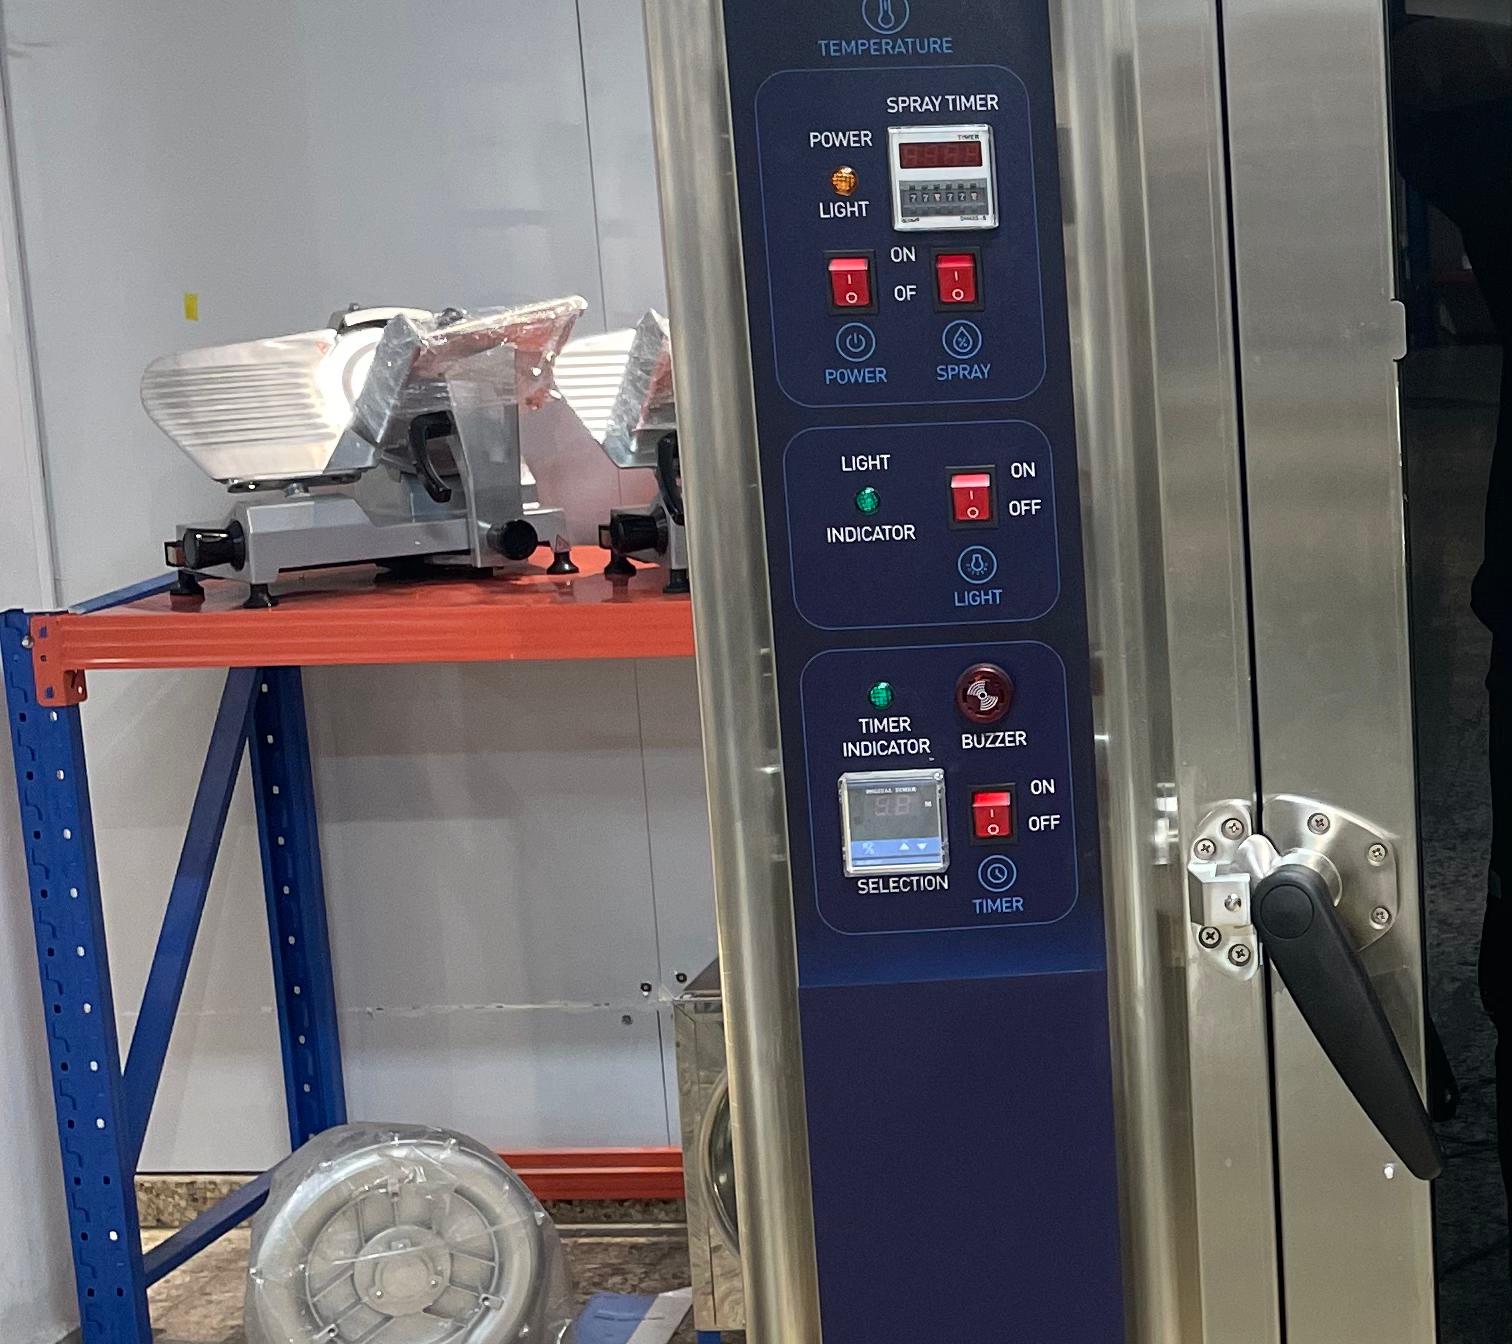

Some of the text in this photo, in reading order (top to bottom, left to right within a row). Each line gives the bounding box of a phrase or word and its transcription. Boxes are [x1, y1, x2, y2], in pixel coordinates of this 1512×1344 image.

[818, 38, 953, 57] TEMPERATURE
[887, 94, 999, 113] SPRAY TIMER
[810, 131, 872, 147] POWER
[819, 201, 869, 218] LIGHT
[890, 246, 916, 263] ON
[894, 285, 917, 301] OF
[825, 368, 887, 384] POWER
[936, 364, 991, 381] SPRAY
[841, 454, 891, 472] LIGHT
[1011, 462, 1036, 478] ON
[1009, 499, 1042, 516] OFF
[827, 524, 916, 543] INDICATOR
[954, 589, 1003, 607] LIGHT
[859, 716, 912, 734] TIMER
[843, 738, 931, 757] INDICATOR
[961, 731, 1027, 749] BUZZER
[1031, 779, 1055, 795] ON
[1028, 814, 1061, 831] OFF
[857, 875, 949, 894] SELECTION
[973, 897, 1024, 914] TIMER
